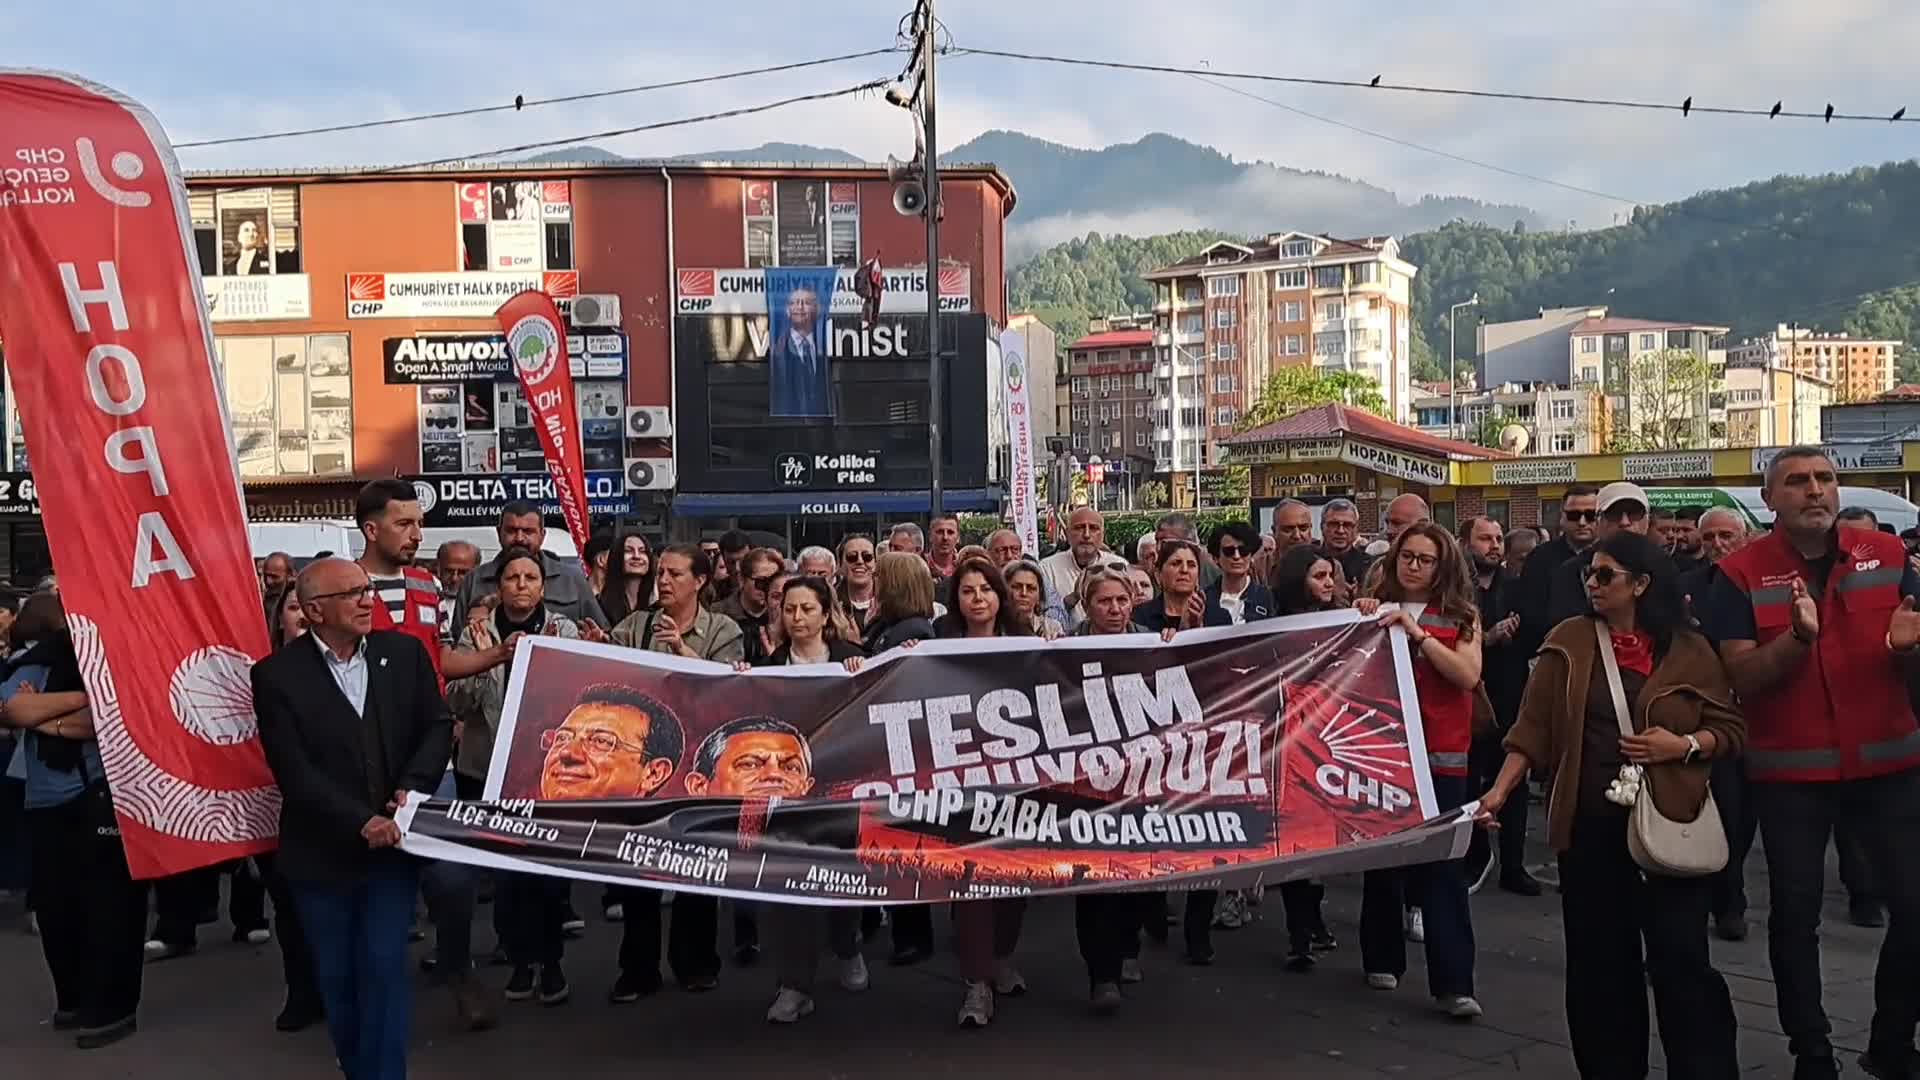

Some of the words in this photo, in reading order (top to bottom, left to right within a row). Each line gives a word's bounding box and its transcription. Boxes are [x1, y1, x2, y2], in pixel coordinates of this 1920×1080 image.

[831, 203, 856, 214] CHP
[389, 281, 461, 297] CUMHURİYET
[464, 281, 494, 296] HALK
[881, 272, 928, 293] ARTİS
[351, 303, 383, 314] CHP
[680, 299, 712, 310] CHP
[939, 298, 969, 309] CHP
[393, 338, 509, 361] Akuvox
[394, 362, 427, 378] Open
[430, 361, 439, 373] A
[441, 361, 474, 374] Smart
[476, 361, 509, 371] World
[815, 455, 875, 469] Koliba
[1349, 443, 1398, 467] HOPAM
[837, 471, 875, 483] Pide
[1273, 475, 1312, 486] HOPAM
[441, 480, 507, 500] DELTA
[448, 506, 474, 516] AKILLI
[801, 503, 861, 514] KOLIBA
[1855, 559, 1880, 571] CHP
[868, 662, 1203, 776] TESLİM
[1316, 764, 1411, 812] CHP
[888, 786, 964, 826] CHP
[970, 790, 1061, 843] BABA
[1070, 805, 1248, 844] OCAĞIDIR
[489, 811, 559, 841] ÖRGÜTÜ
[658, 848, 728, 882] ÖRGÜTÜ
[806, 865, 867, 886] ARHAVİ
